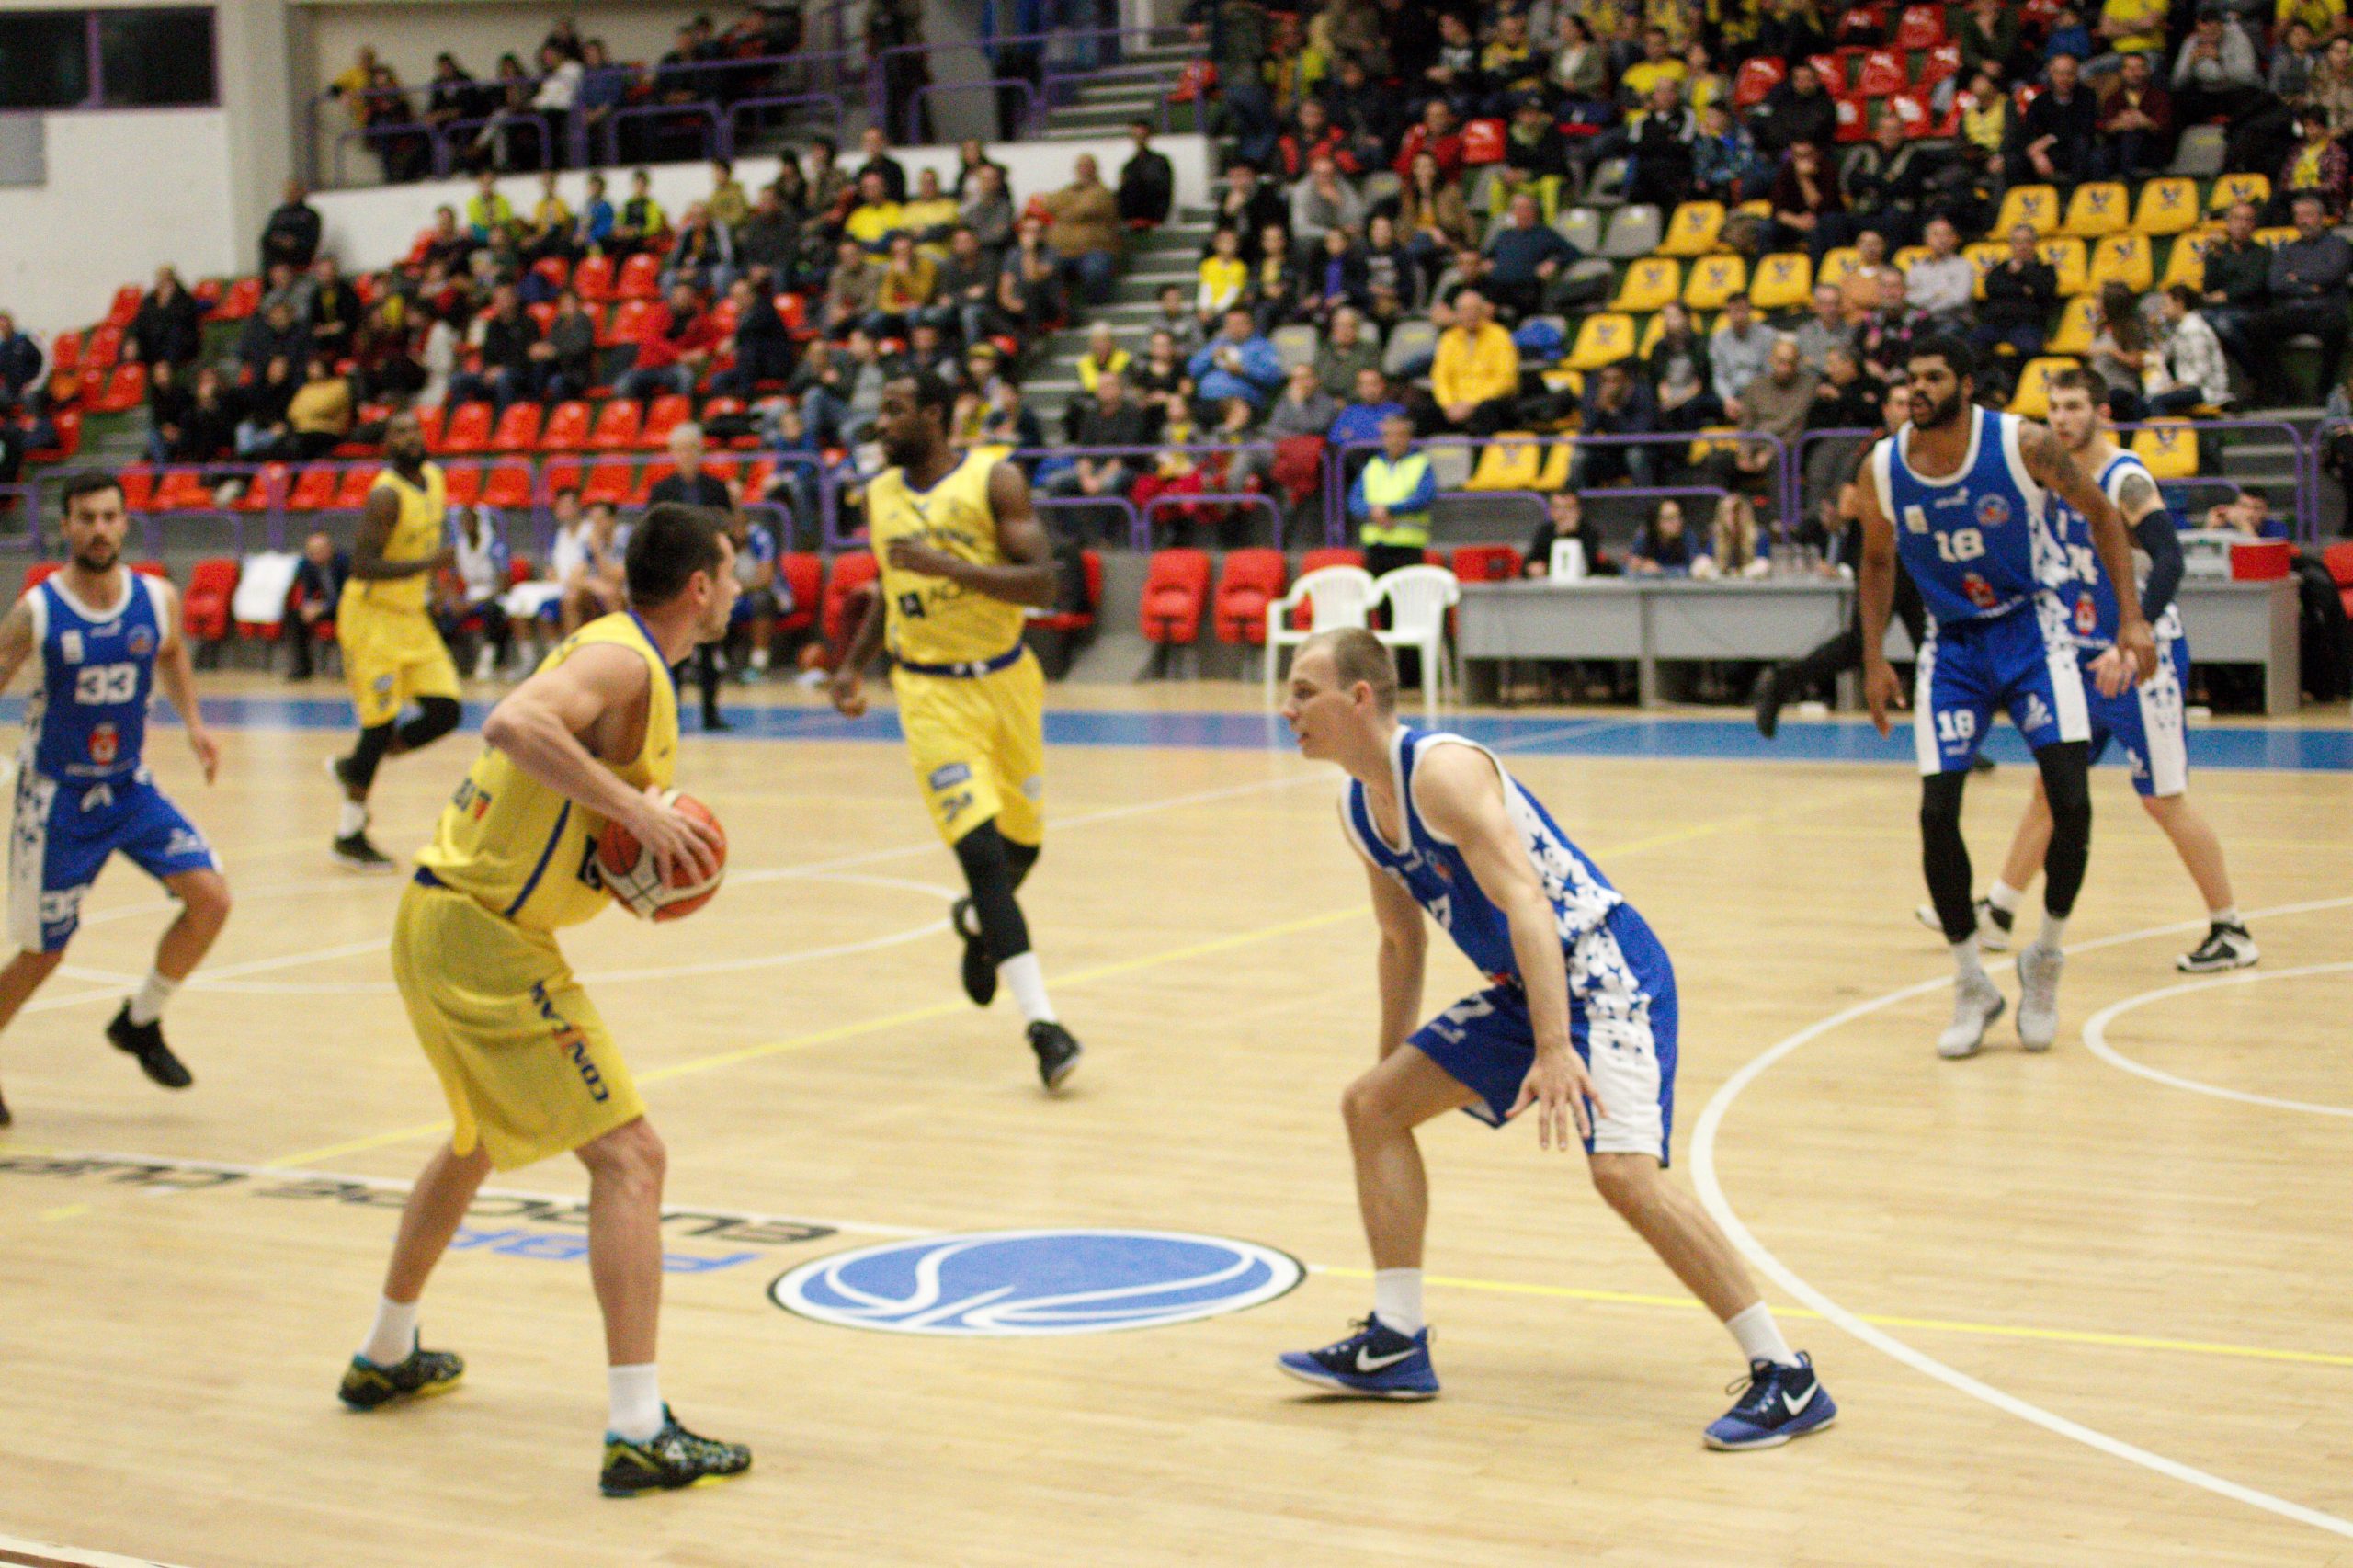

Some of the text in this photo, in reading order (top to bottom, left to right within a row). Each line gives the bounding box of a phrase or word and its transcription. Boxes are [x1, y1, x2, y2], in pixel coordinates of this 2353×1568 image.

[1934, 527, 1985, 563] 18
[74, 662, 138, 705] 33
[1937, 709, 1975, 742] 18
